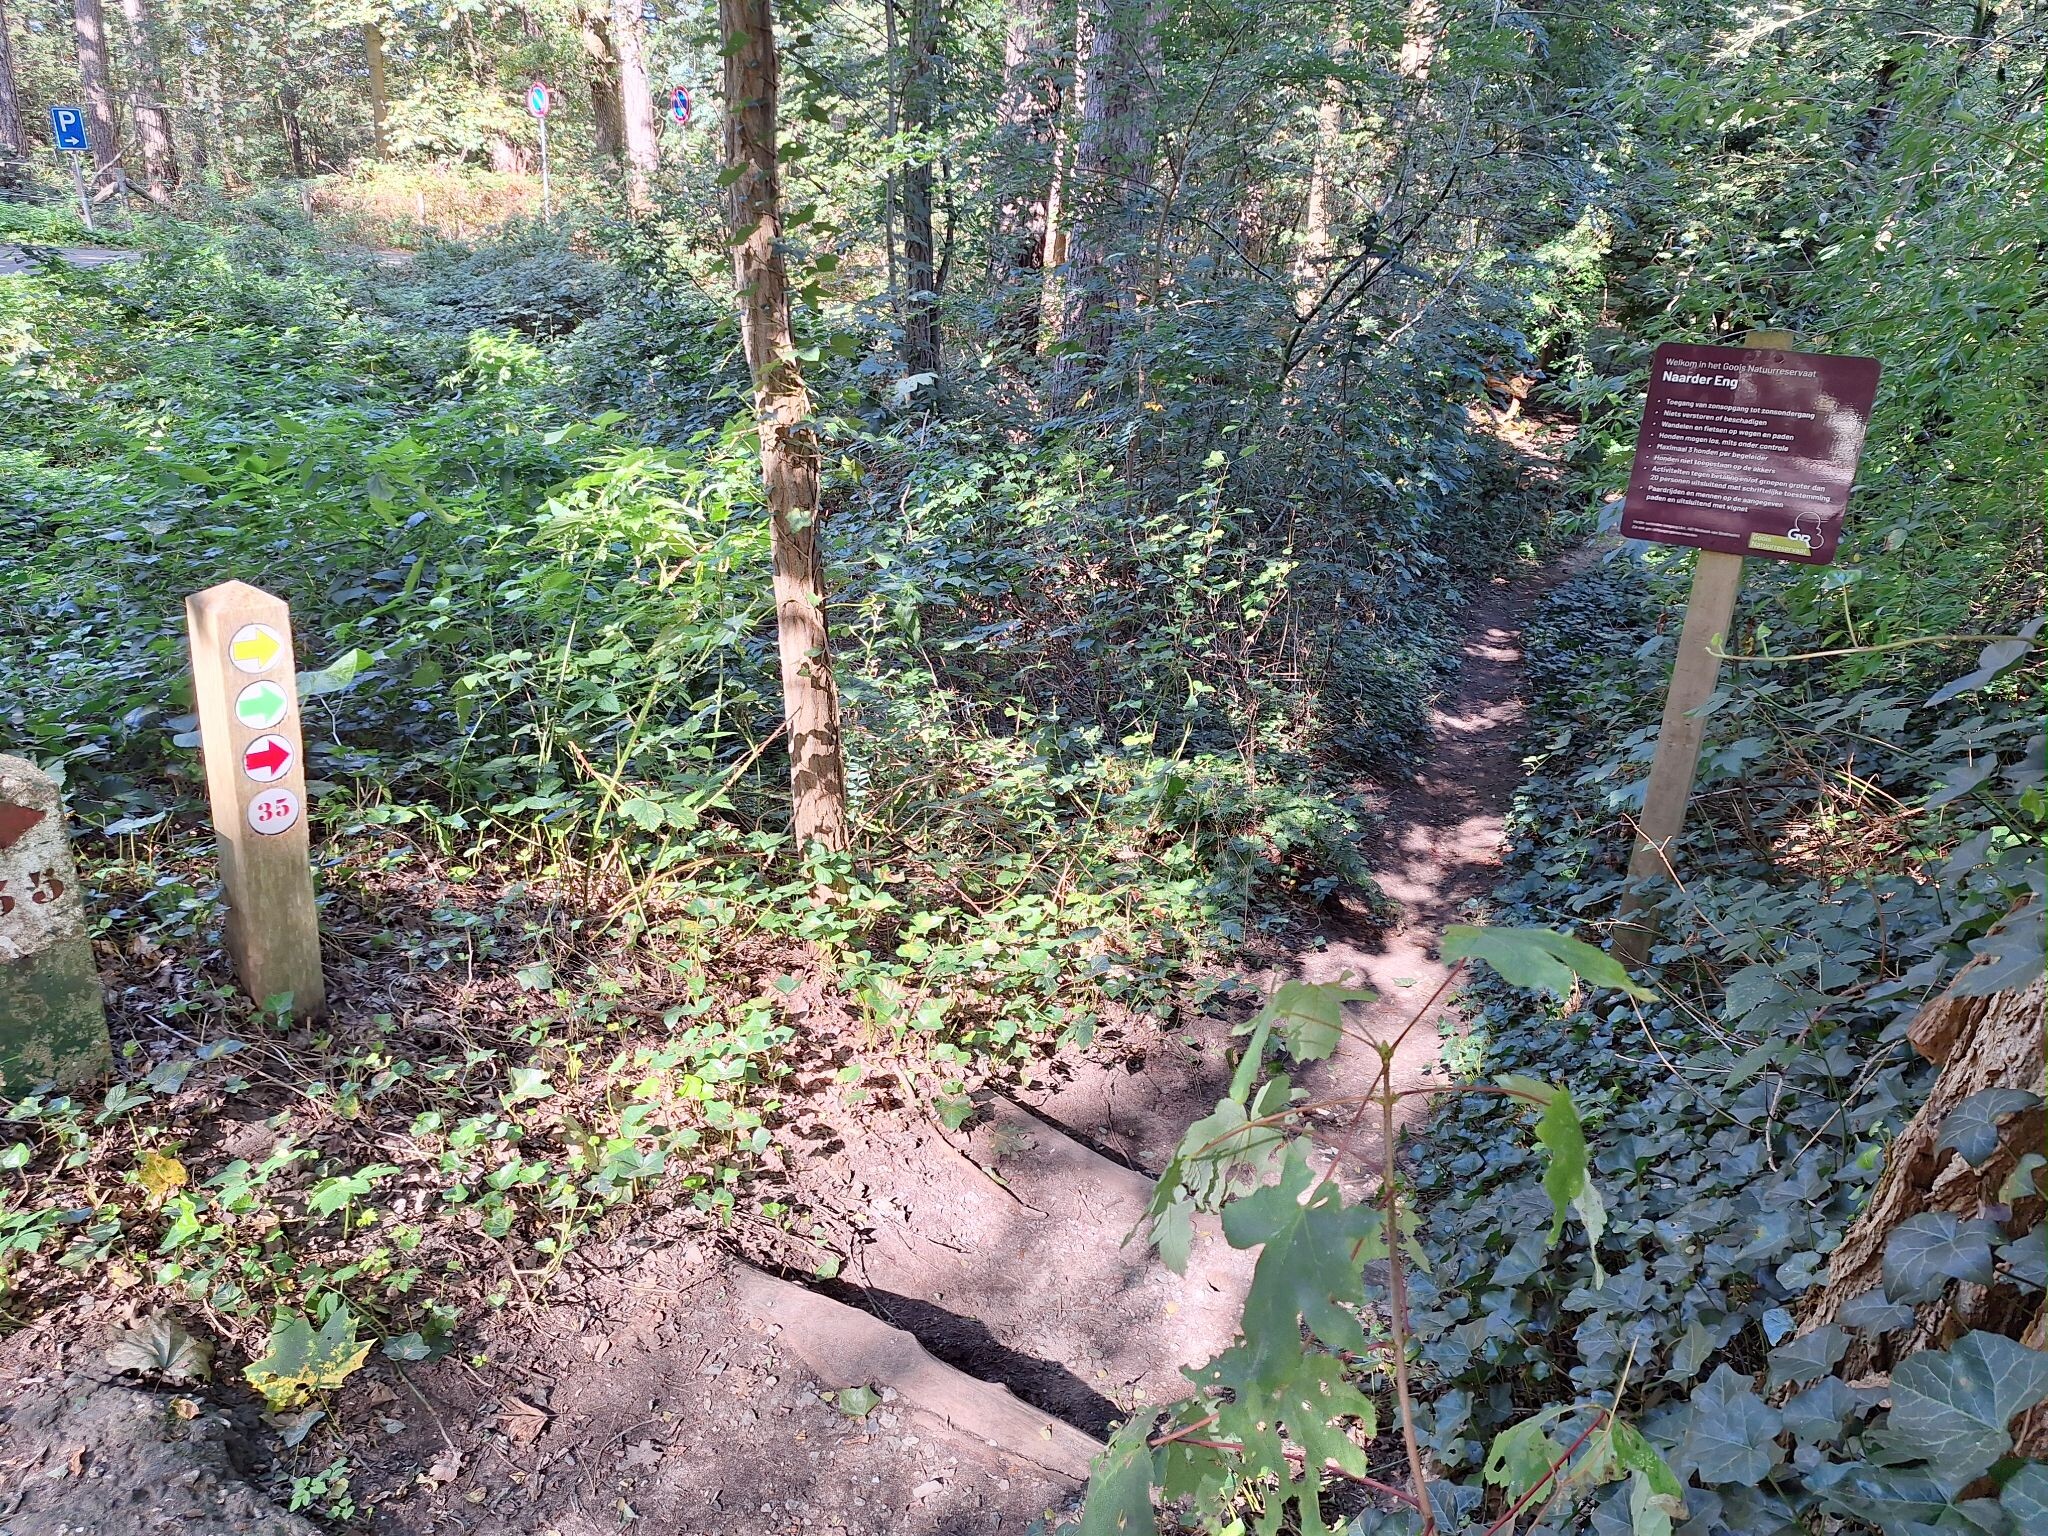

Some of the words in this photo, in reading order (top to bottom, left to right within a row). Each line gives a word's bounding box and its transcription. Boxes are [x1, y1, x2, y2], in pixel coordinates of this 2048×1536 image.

[58, 111, 76, 132] P
[1666, 358, 1697, 368] Welkom
[1708, 362, 1721, 370] het
[1723, 363, 1746, 372] Goois
[1748, 364, 1816, 378] Natuurreservaat
[1662, 371, 1713, 385] Naarder
[1714, 376, 1738, 390] Eng
[1666, 399, 1694, 408] Toegang
[1708, 404, 1749, 414] zonsopgang
[1761, 408, 1816, 420] zonsondergang
[1682, 412, 1714, 420] verstoren
[1724, 416, 1768, 426] beschadigen
[1659, 432, 1684, 440] Honden
[1662, 421, 1694, 430] Wandelen
[1704, 426, 1728, 434] fietsen
[1738, 430, 1761, 438] wegen
[1772, 432, 1794, 441] paden
[1656, 444, 1687, 452] Maximaal
[1694, 447, 1718, 456] honden
[1732, 452, 1768, 461] begeleider
[1694, 458, 1732, 468] toegestaan
[1652, 466, 1690, 476] Activiteiten
[1711, 473, 1738, 482] betaling
[1759, 480, 1788, 488] groepen
[1648, 485, 1685, 495] Paardrijden
[1742, 498, 1784, 508] aangegeven
[1660, 476, 1690, 485] personen
[1691, 480, 1727, 489] uitsluitend
[1742, 486, 1783, 496] schriftelijke
[1784, 491, 1830, 502] toestemming
[1676, 498, 1711, 508] uitsluitend
[1751, 541, 1807, 554] Natuurreservaat
[258, 798, 290, 822] 35
